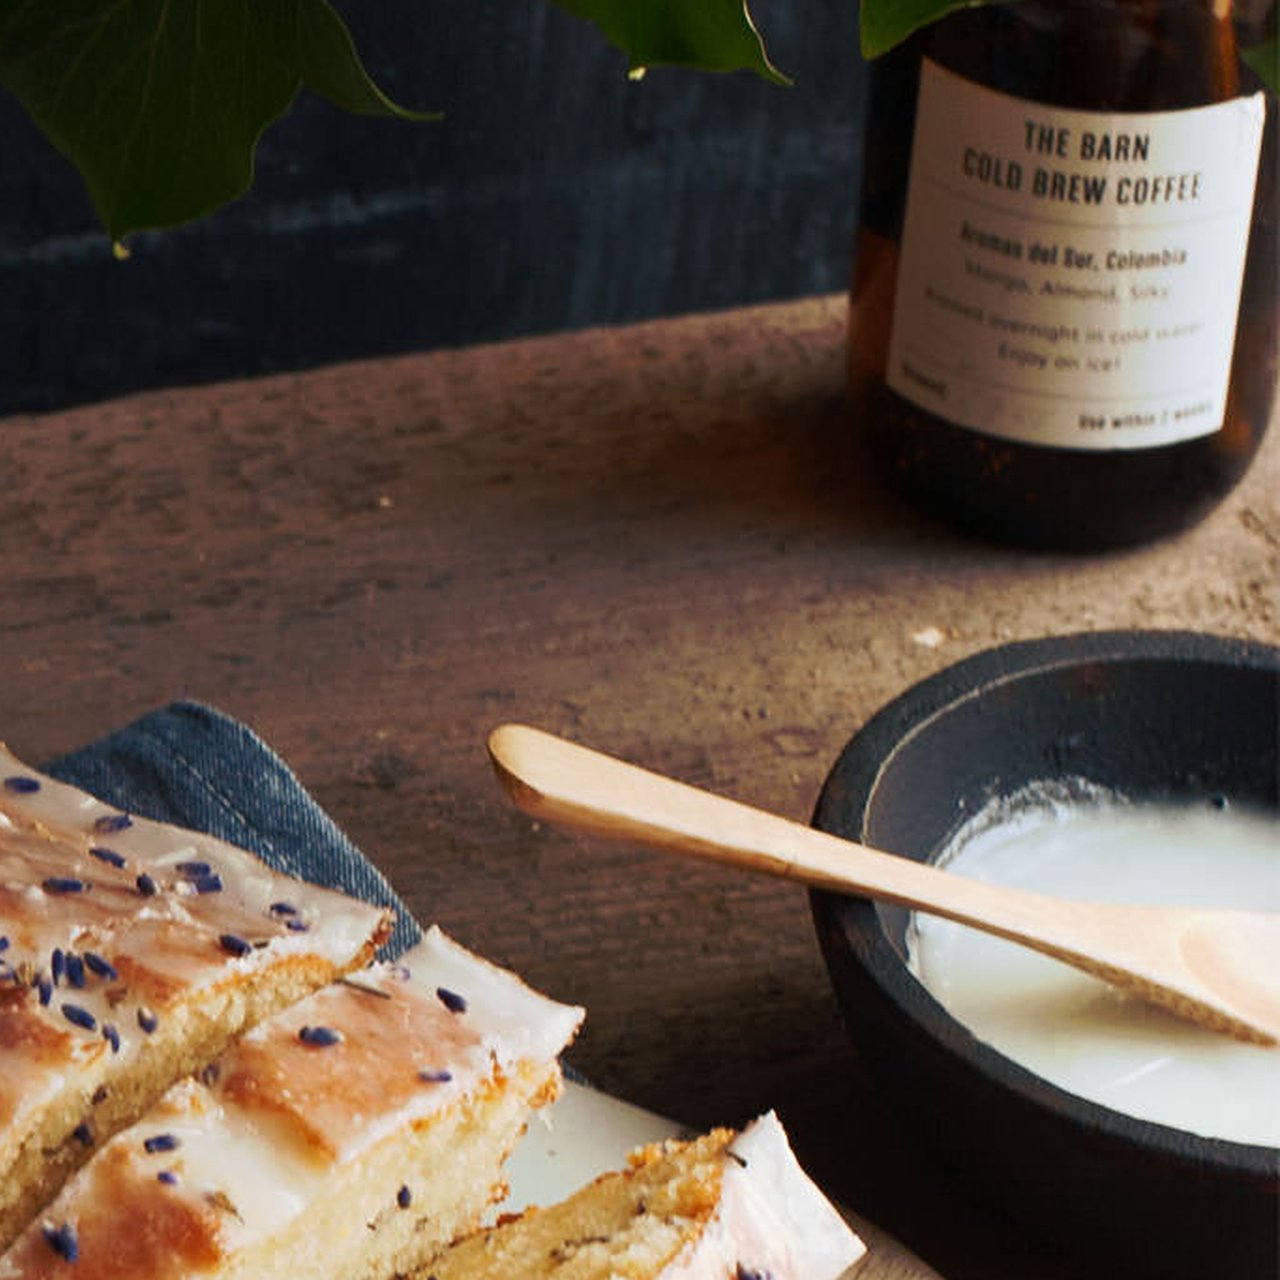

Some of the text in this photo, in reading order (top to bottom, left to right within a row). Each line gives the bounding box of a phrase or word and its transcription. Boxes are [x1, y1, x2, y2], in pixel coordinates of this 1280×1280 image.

[1024, 119, 1150, 161] THE BARN
[963, 147, 1201, 206] COLD BREW COFFEE
[1105, 248, 1187, 271] Colombia
